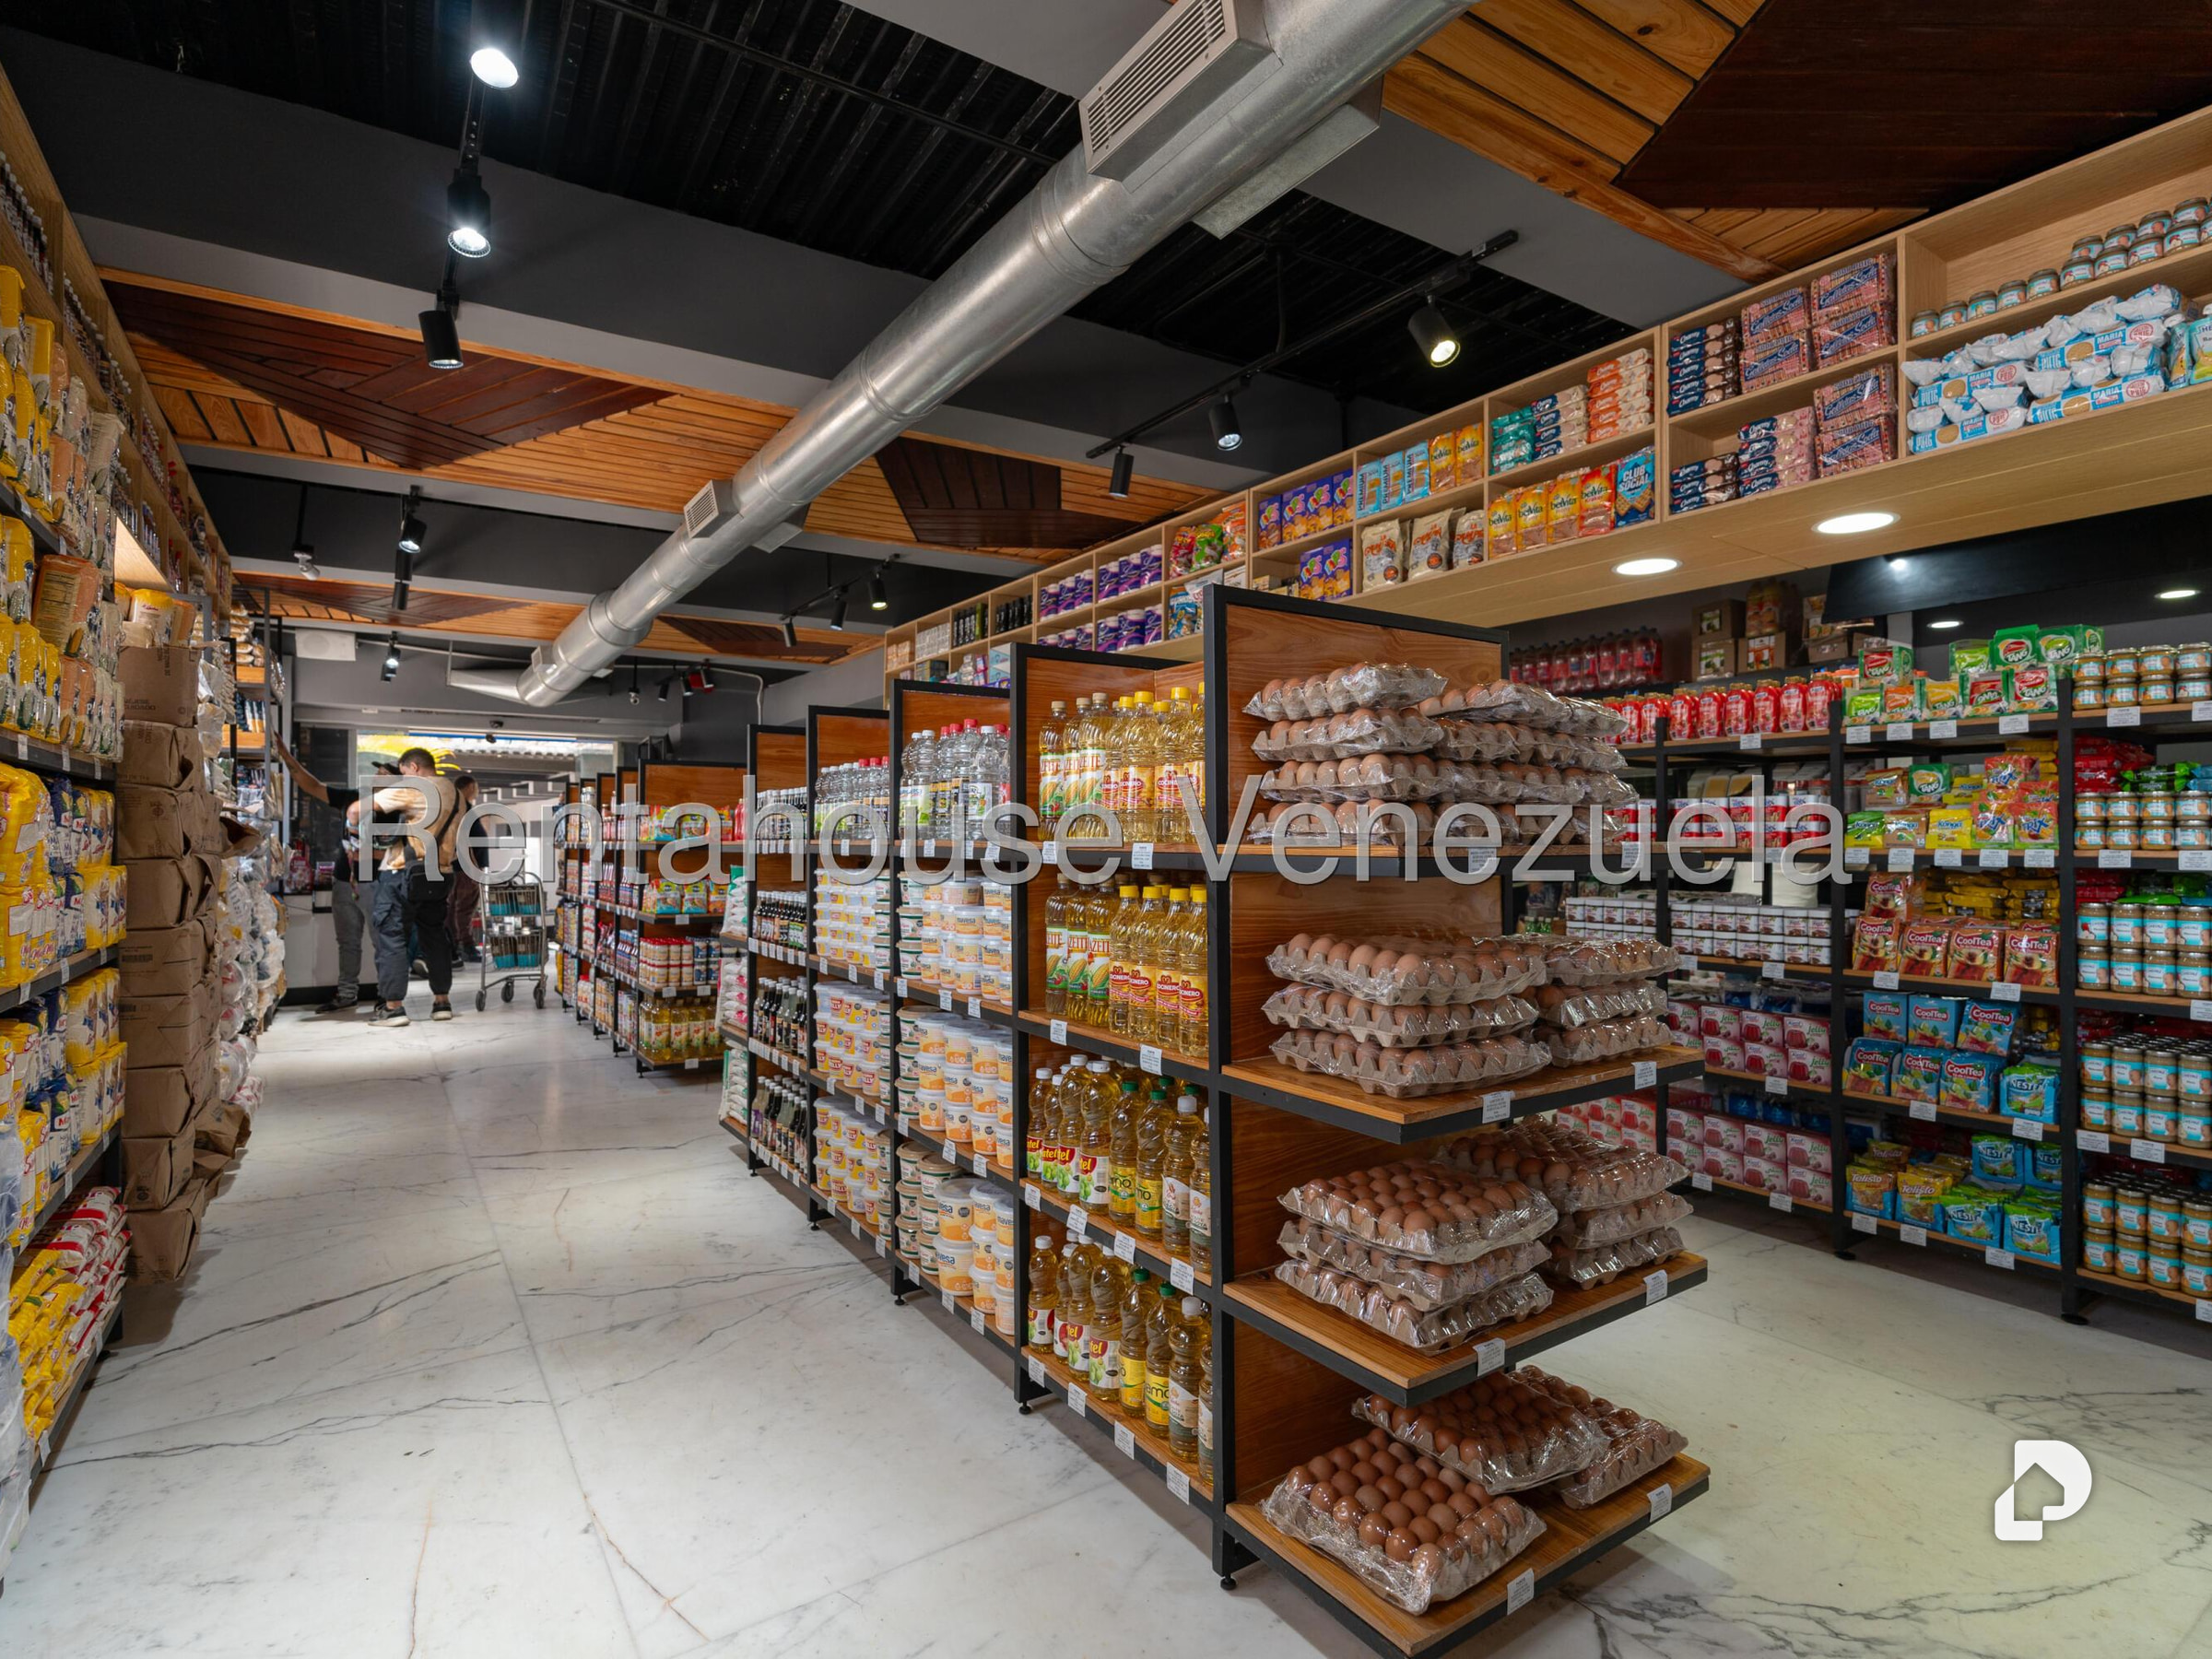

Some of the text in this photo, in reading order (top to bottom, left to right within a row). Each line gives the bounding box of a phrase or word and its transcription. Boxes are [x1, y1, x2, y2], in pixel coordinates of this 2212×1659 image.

[2097, 331, 2124, 345] MARIA
[1623, 465, 1645, 481] CLUB
[1618, 475, 1649, 492] SOCIAL
[2006, 650, 2028, 661] TANG
[1874, 884, 1901, 893] CoolTea
[1861, 924, 1892, 933] CoolTea
[1909, 934, 1942, 943] CoolTea
[1957, 936, 1992, 947] CoolTea
[2011, 938, 2048, 950] CoolTea
[1871, 1004, 1899, 1012] CoolTea
[1916, 1008, 1947, 1019] CoolTea
[1973, 1009, 2010, 1022] CoolTea
[1858, 1053, 1888, 1063] CoolTea
[1906, 1058, 1939, 1069] CoolTea
[1947, 1065, 1983, 1077] CoolTea
[1852, 1173, 1882, 1182] Telisto
[1902, 1185, 1935, 1194] Telisto
